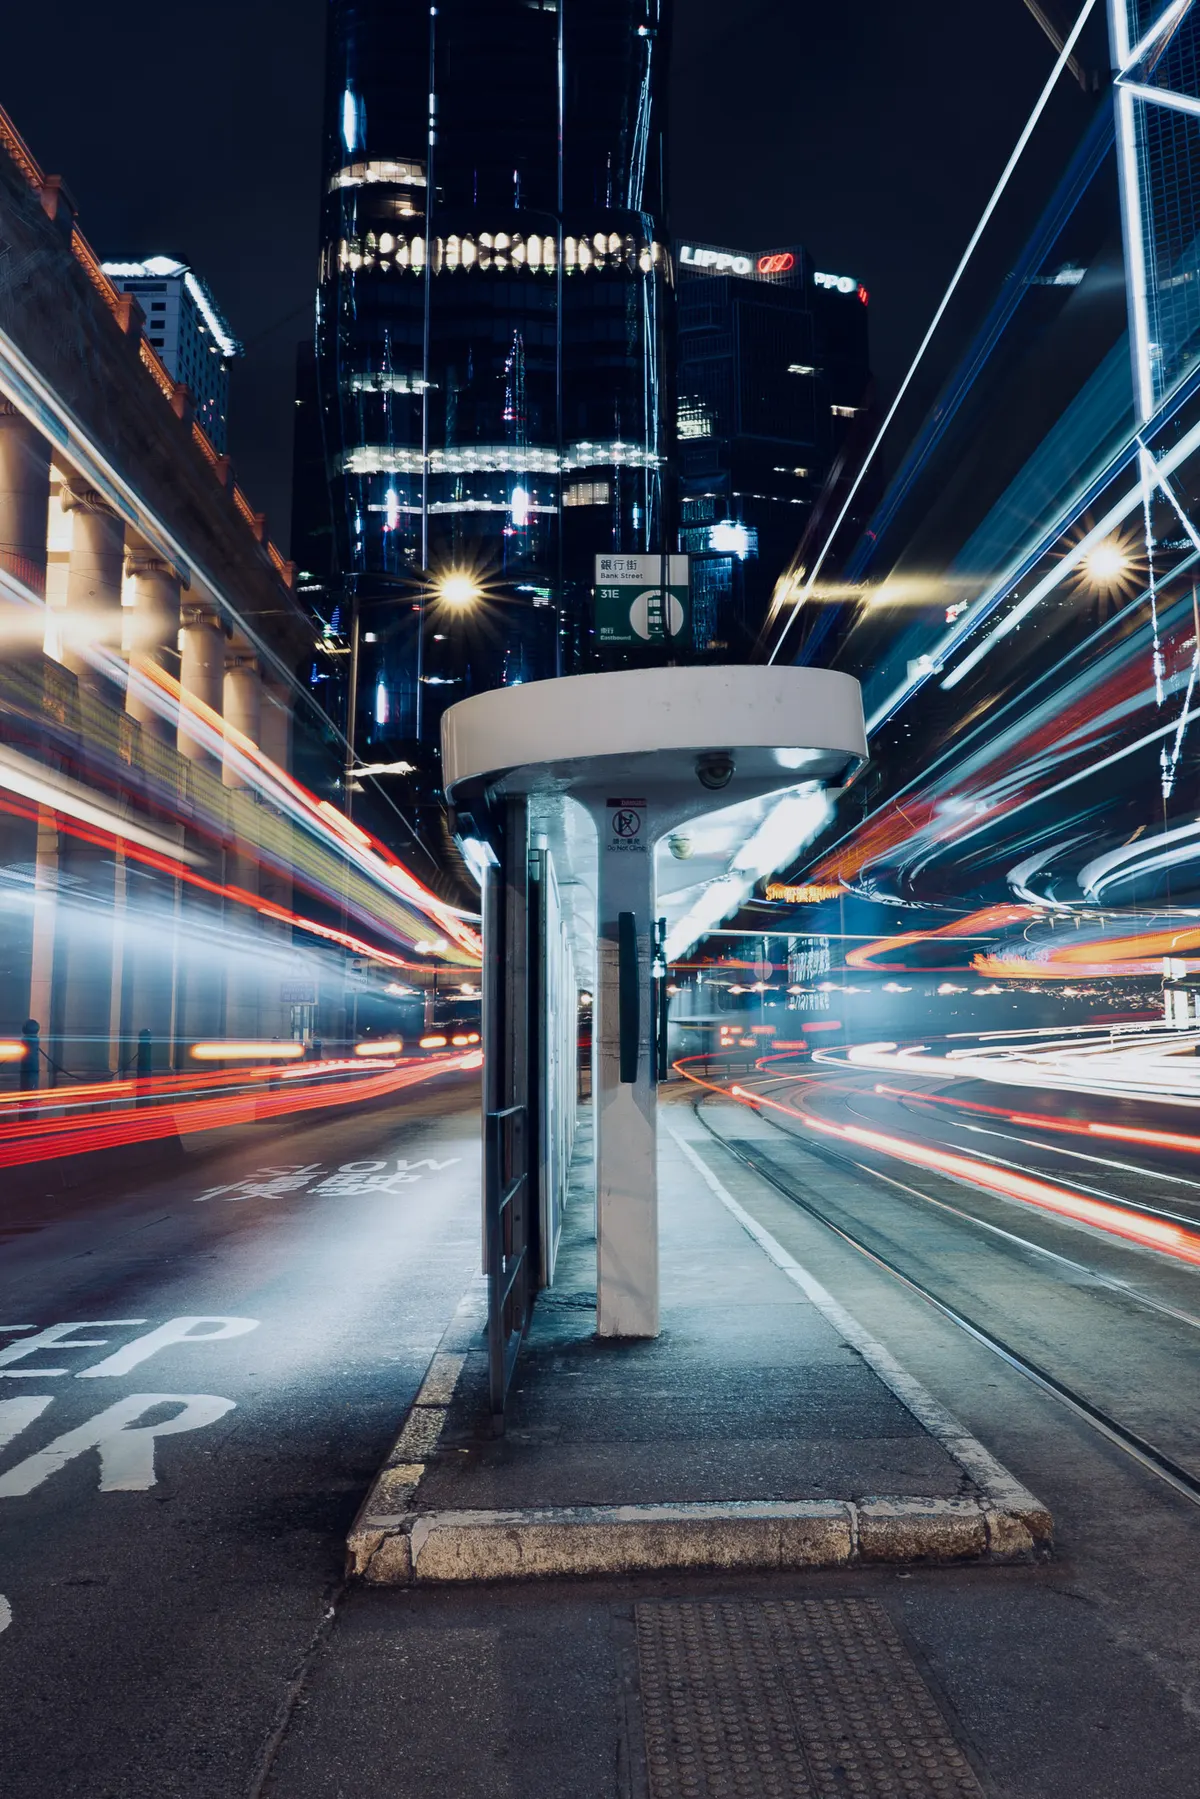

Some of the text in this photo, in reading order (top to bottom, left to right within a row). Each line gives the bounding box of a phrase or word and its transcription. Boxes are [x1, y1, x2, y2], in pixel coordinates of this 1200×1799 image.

[679, 246, 753, 275] LIPPO
[600, 559, 637, 571] 銀行街
[600, 589, 620, 599] 31E
[245, 1158, 462, 1178] SLOW
[193, 1171, 422, 1202] 慢駛
[0, 1315, 261, 1379] EP
